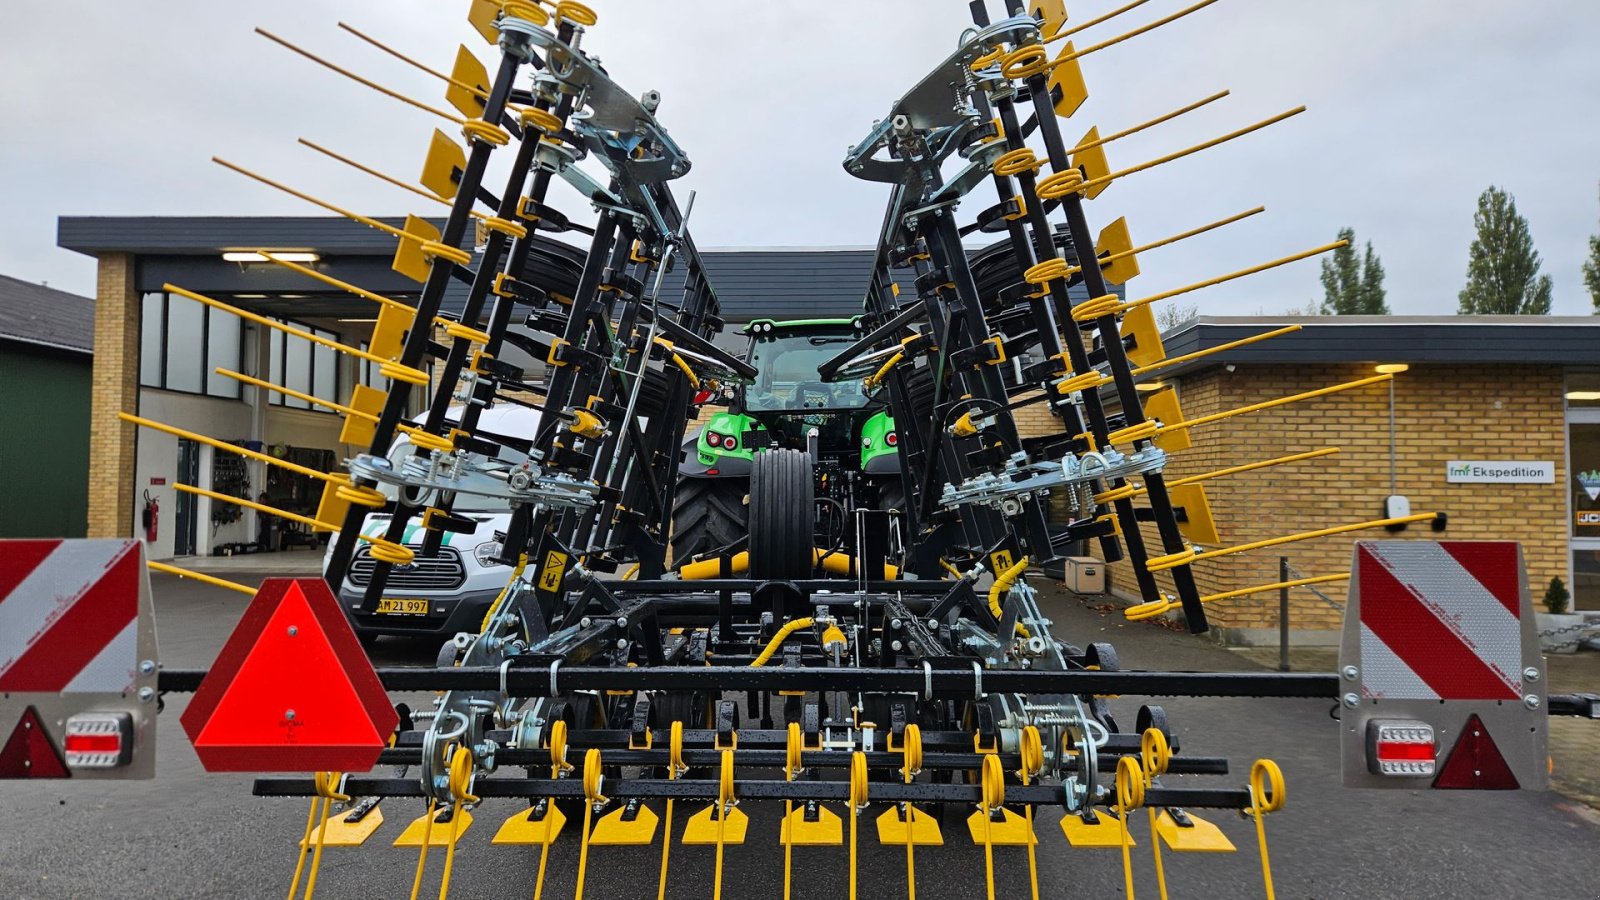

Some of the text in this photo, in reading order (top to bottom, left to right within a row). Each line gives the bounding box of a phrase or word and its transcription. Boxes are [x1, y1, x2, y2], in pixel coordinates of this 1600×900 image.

[1473, 467, 1544, 478] Ekspedition
[1580, 513, 1600, 523] JC
[393, 601, 404, 611] 21
[407, 601, 426, 612] 997
